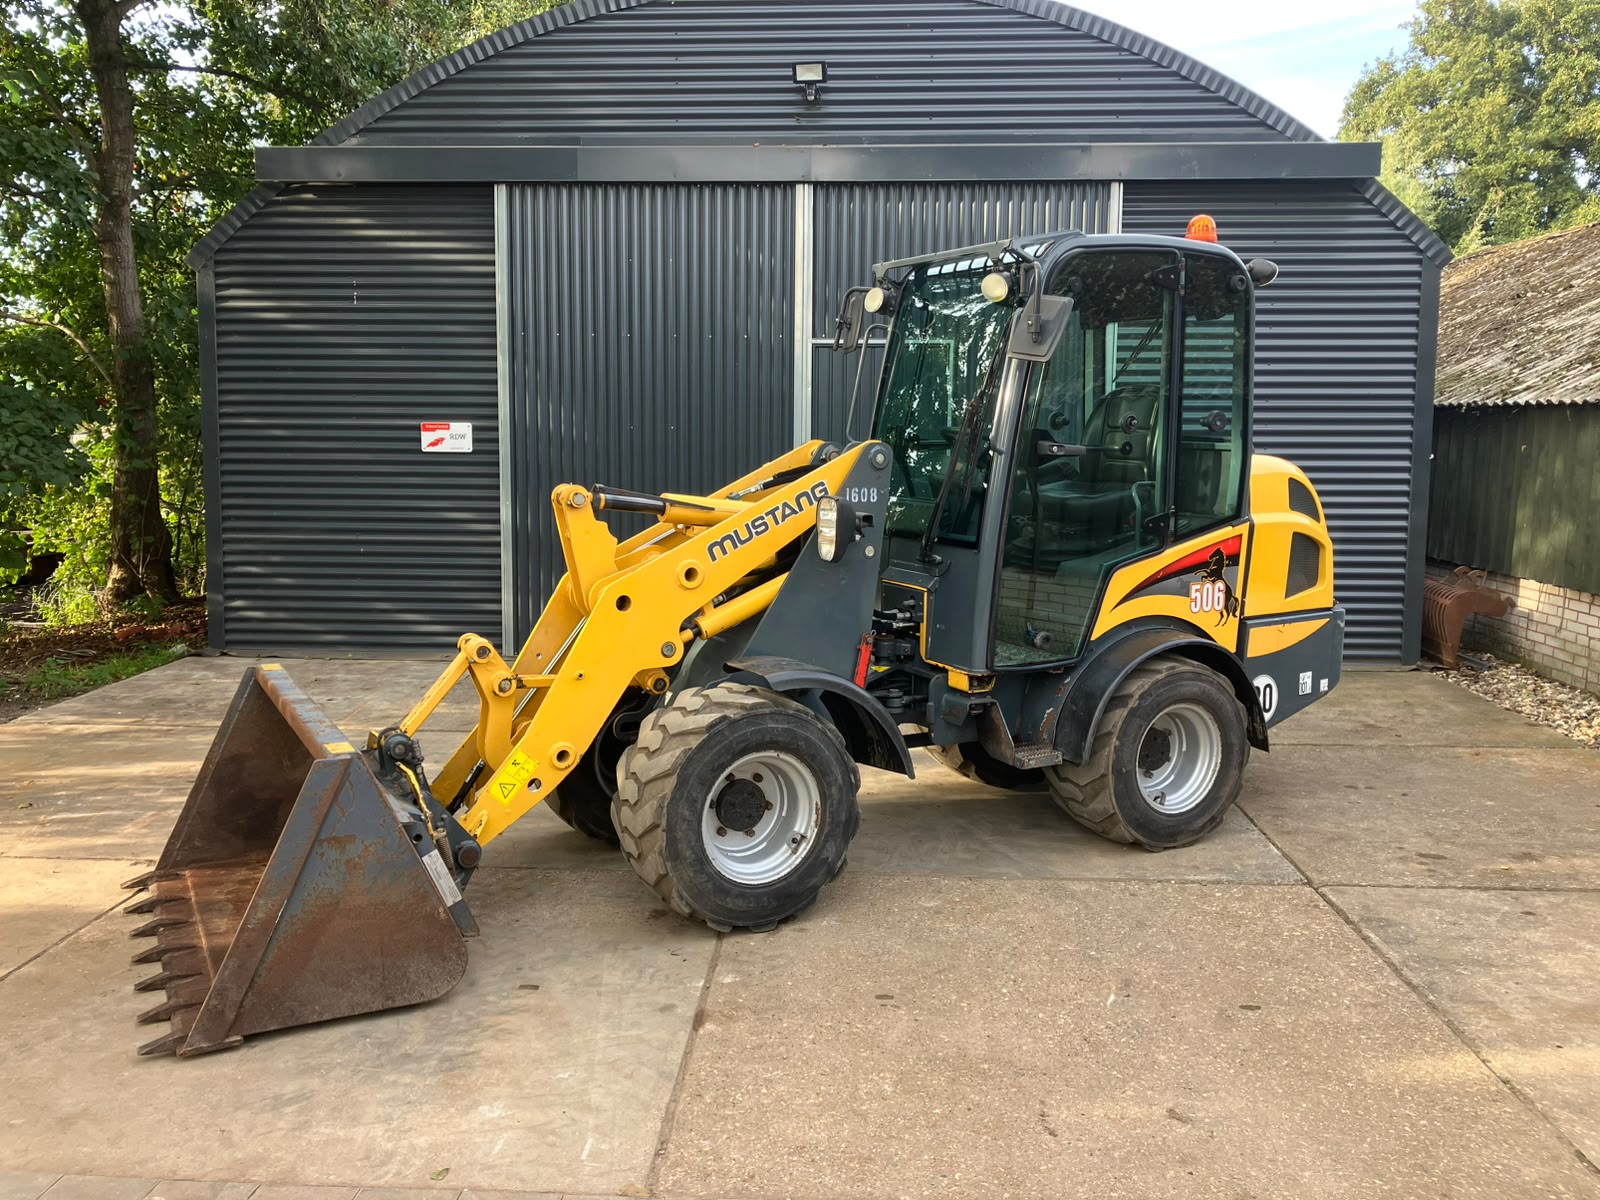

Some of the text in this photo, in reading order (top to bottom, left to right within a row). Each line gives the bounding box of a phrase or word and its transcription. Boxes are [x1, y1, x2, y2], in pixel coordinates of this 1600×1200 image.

[846, 487, 878, 503] 1608
[707, 480, 829, 562] MUSTANG
[1190, 580, 1226, 614] 506
